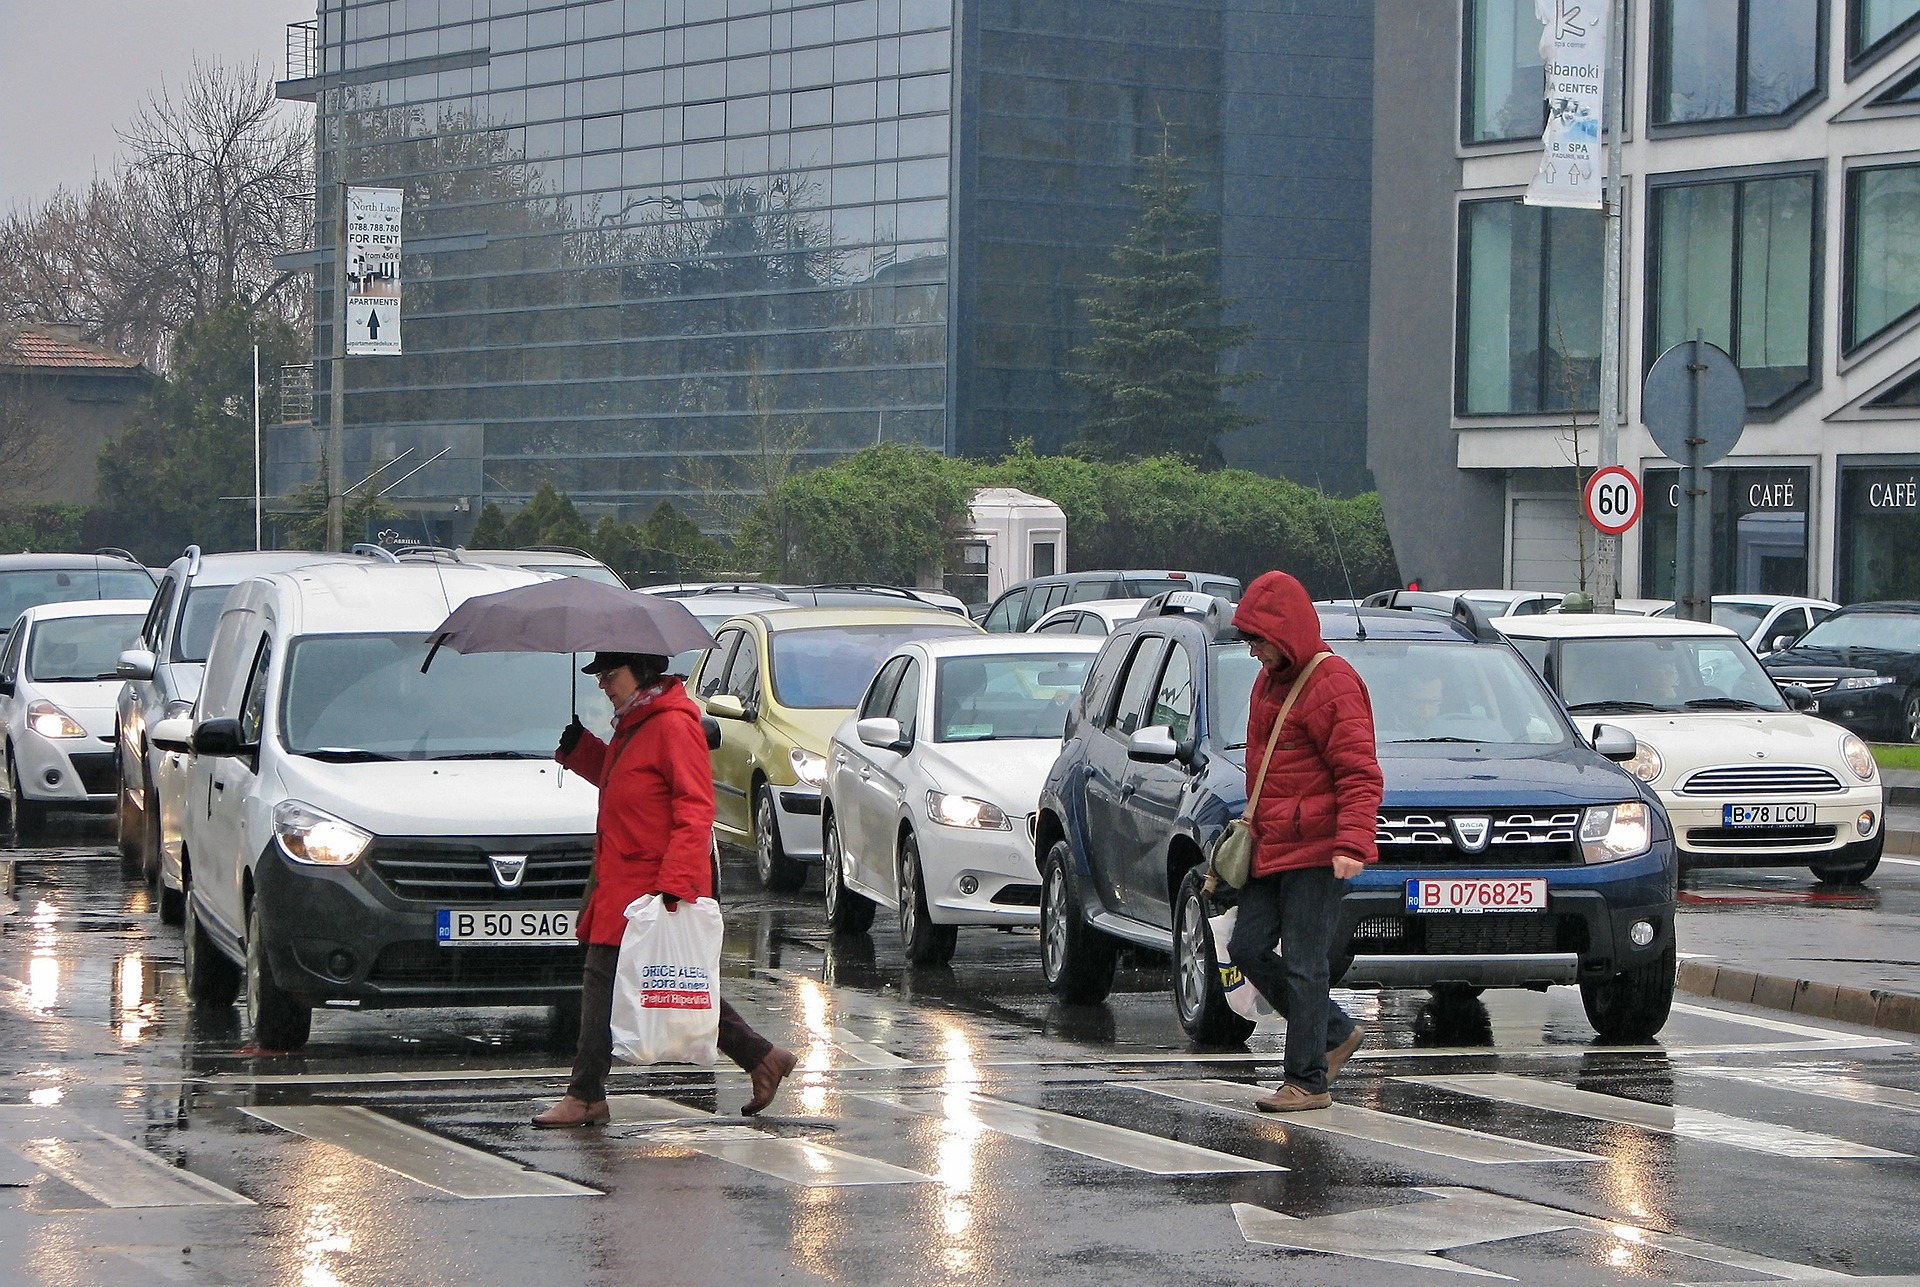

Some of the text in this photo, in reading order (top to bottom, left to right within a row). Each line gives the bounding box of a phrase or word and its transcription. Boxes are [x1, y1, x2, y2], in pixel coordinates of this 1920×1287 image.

[1558, 82, 1598, 94] CENTER
[1553, 143, 1588, 153] B SPA
[352, 201, 400, 213] North Lane
[349, 222, 399, 232] 0788.788.780
[349, 233, 399, 244] FOR RENT
[365, 252, 381, 260] from
[348, 298, 399, 306] APARTMENTS
[1749, 477, 1794, 507] CAFÉ
[1869, 476, 1917, 507] CAFÉ
[1599, 484, 1629, 515] 60
[1733, 806, 1807, 823] B 78 LCU
[1424, 882, 1534, 906] B 076825
[1408, 897, 1418, 905] RO
[458, 913, 568, 936] B 50 SAG
[439, 927, 449, 937] RO
[651, 979, 676, 989] cora
